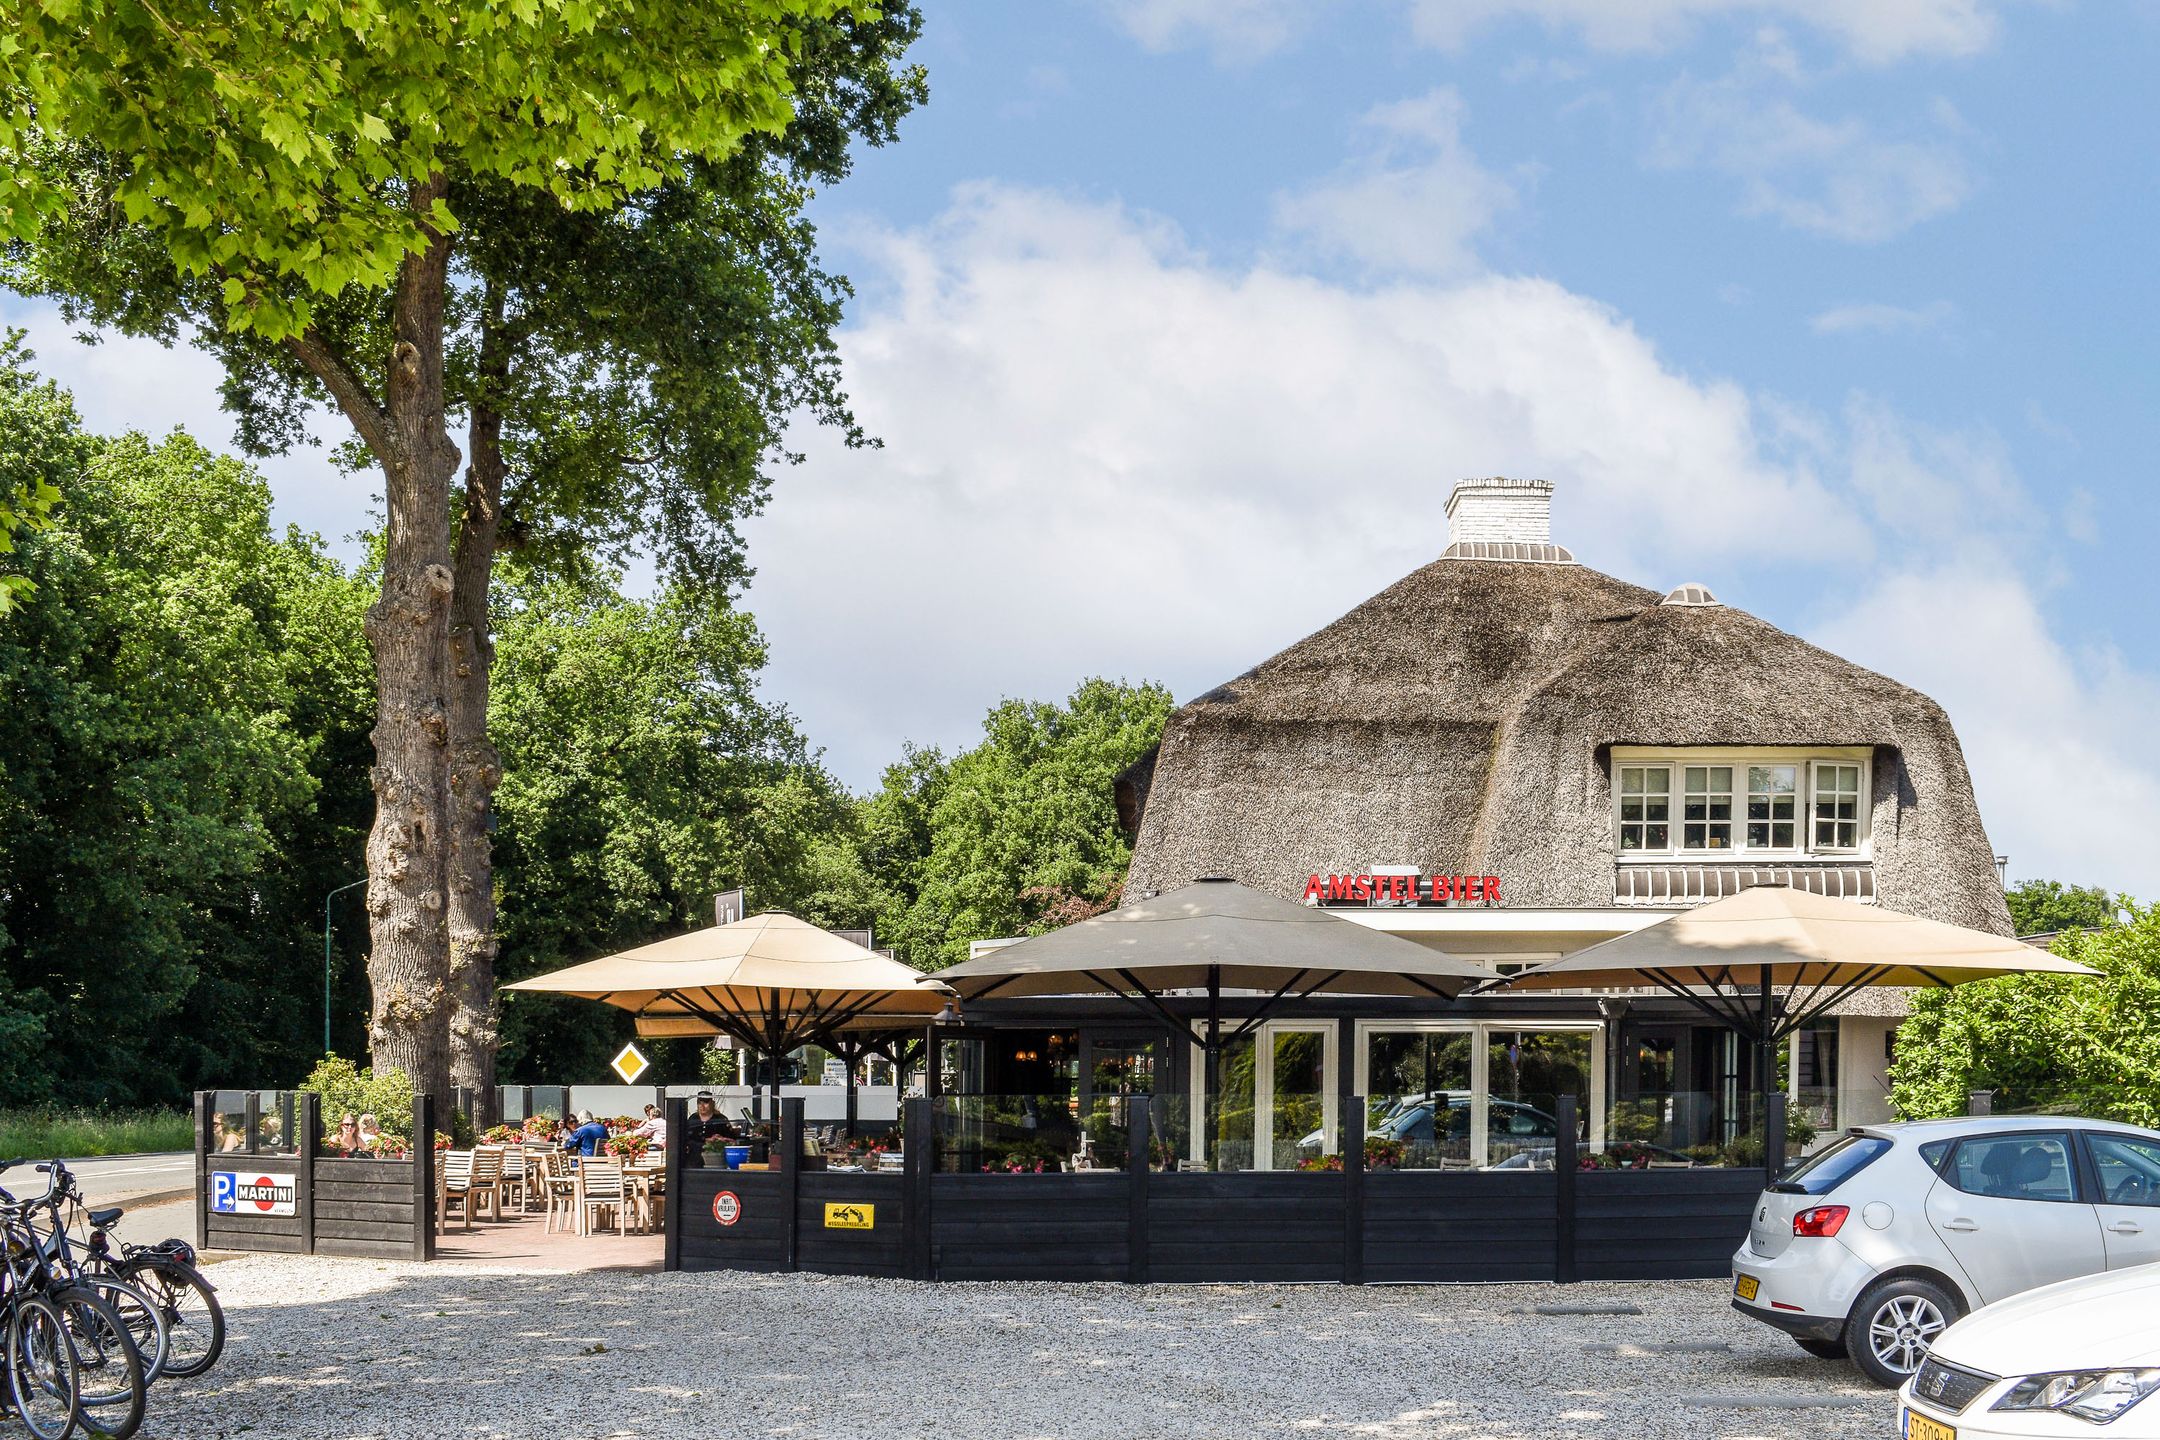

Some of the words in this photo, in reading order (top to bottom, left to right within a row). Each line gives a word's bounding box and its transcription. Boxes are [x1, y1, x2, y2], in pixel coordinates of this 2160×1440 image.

[1303, 875, 1421, 900] AMSTEL
[1430, 875, 1501, 901] BIER
[214, 1175, 230, 1207] P
[238, 1186, 292, 1202] MARTINI
